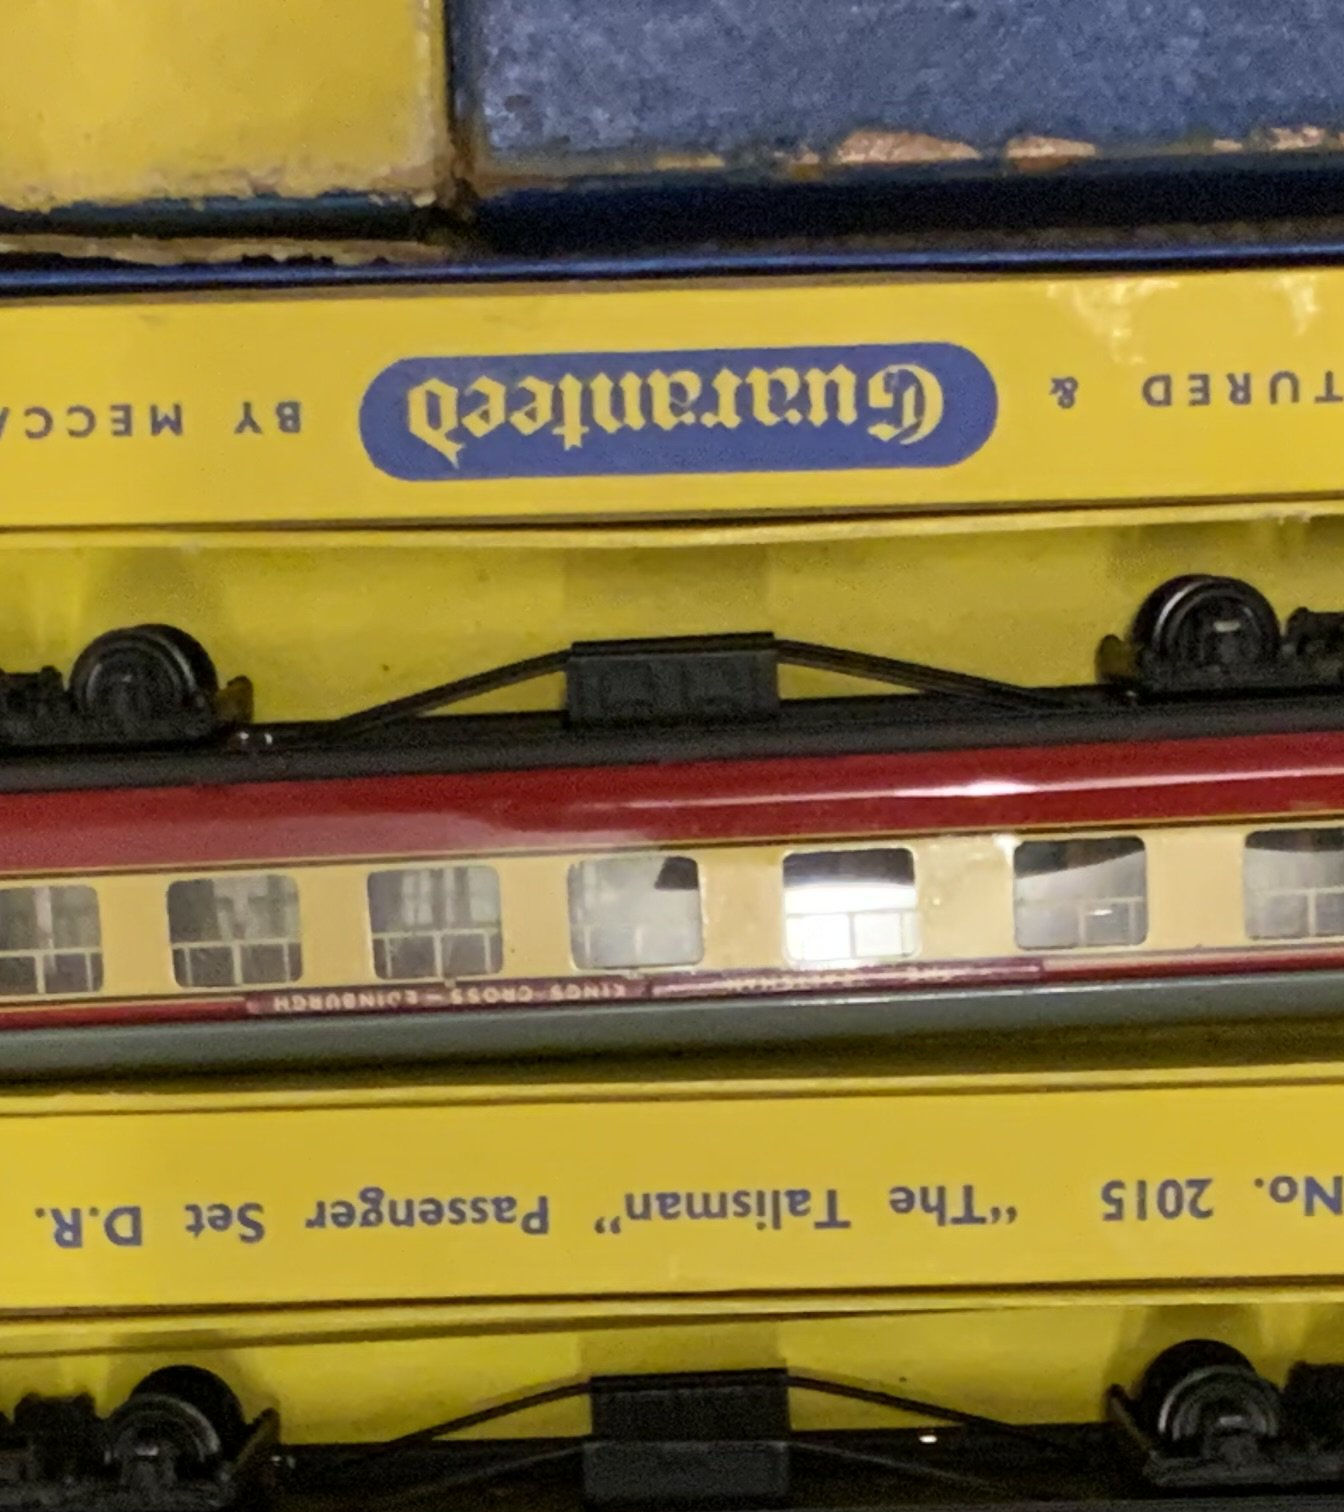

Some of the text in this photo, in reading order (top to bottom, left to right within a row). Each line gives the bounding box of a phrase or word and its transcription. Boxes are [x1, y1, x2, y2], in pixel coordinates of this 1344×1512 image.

[1051, 377, 1078, 407] &
[236, 400, 301, 433] BY
[408, 362, 944, 467] Guaranteed
[450, 986, 532, 1003] CROSS
[33, 1176, 1343, 1248] No. 2015 “The Talisman” Passenger Set D.R.
